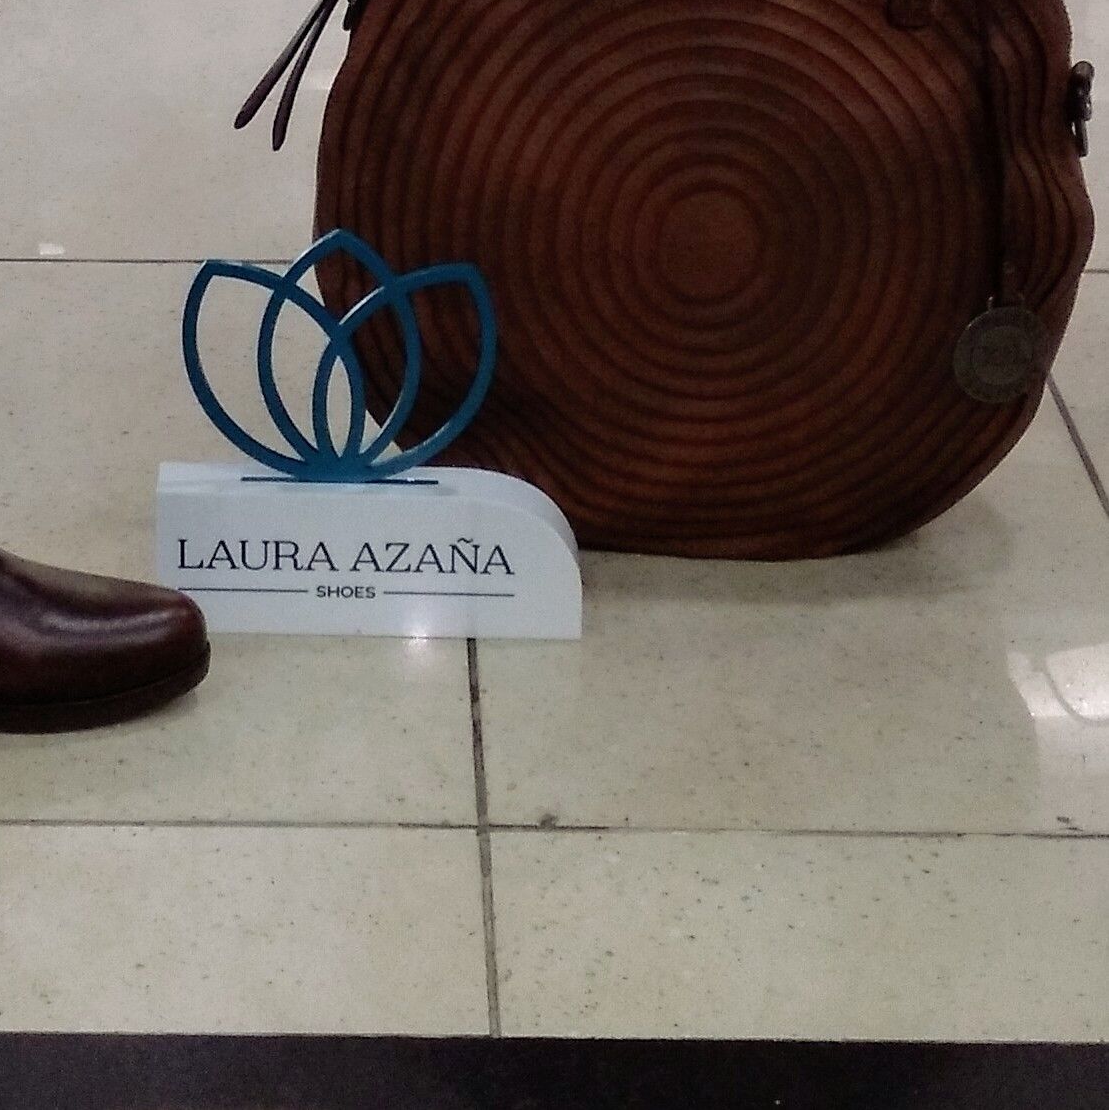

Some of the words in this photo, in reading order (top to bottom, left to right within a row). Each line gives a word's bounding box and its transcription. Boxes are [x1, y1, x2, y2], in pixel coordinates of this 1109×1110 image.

[178, 539, 339, 572] LAURA
[350, 537, 515, 575] AZAÑA
[316, 585, 376, 599] SHOES
